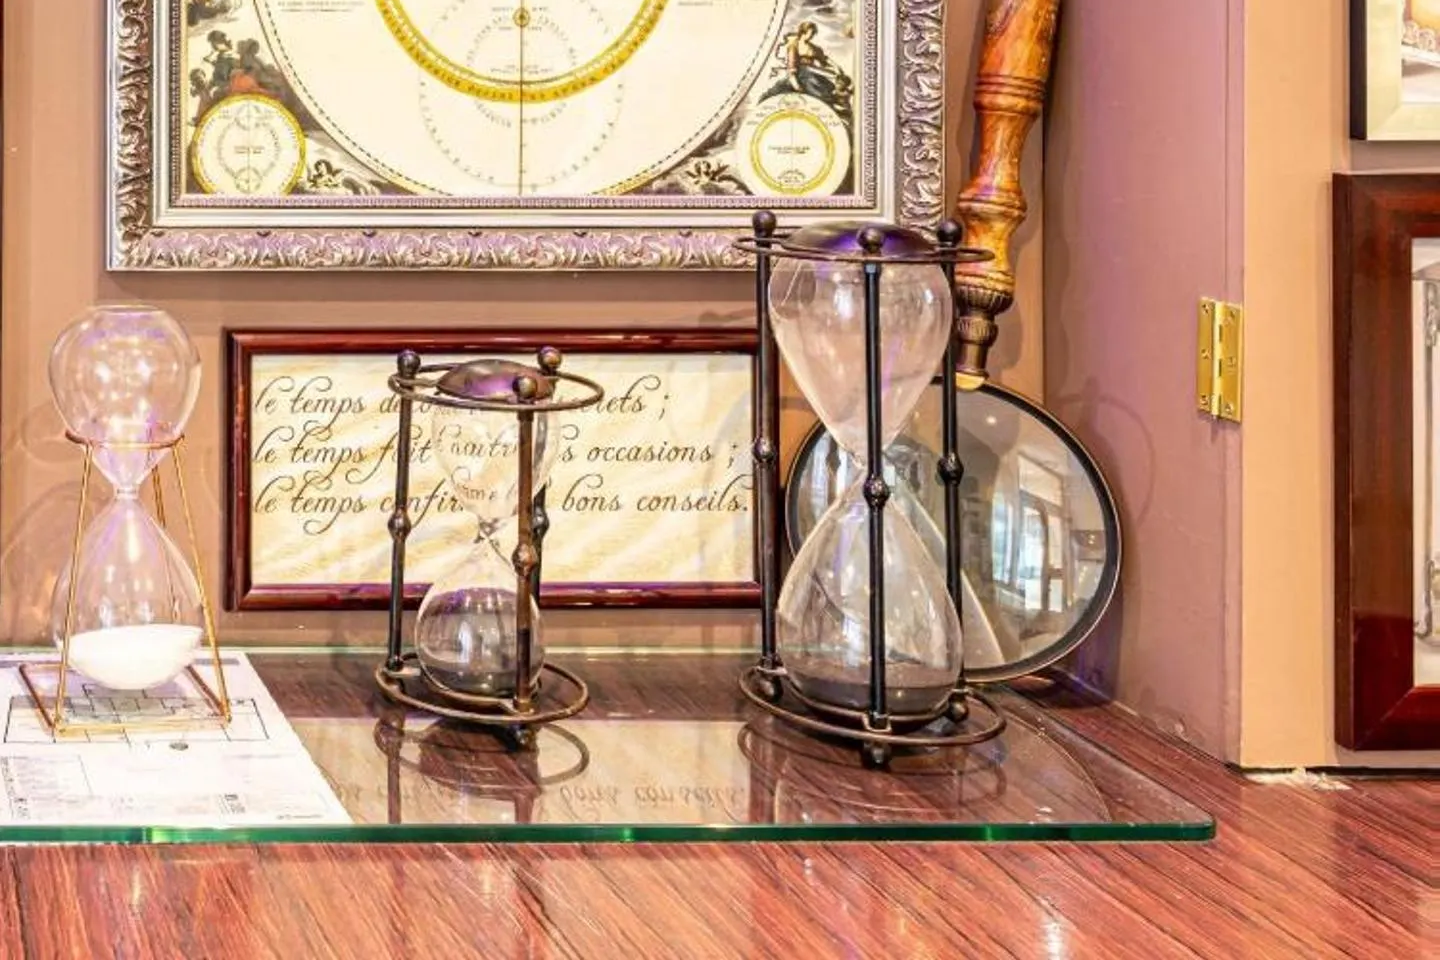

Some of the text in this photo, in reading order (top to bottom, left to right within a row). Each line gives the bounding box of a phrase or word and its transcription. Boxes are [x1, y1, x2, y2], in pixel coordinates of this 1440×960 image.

[254, 375, 296, 415] le
[290, 375, 366, 435] temps
[252, 425, 295, 464] le
[290, 420, 366, 484] temps
[586, 441, 715, 463] occasions
[252, 475, 296, 514] le
[290, 470, 366, 536] temps
[562, 473, 621, 513] bons
[636, 473, 754, 513] conseils.
